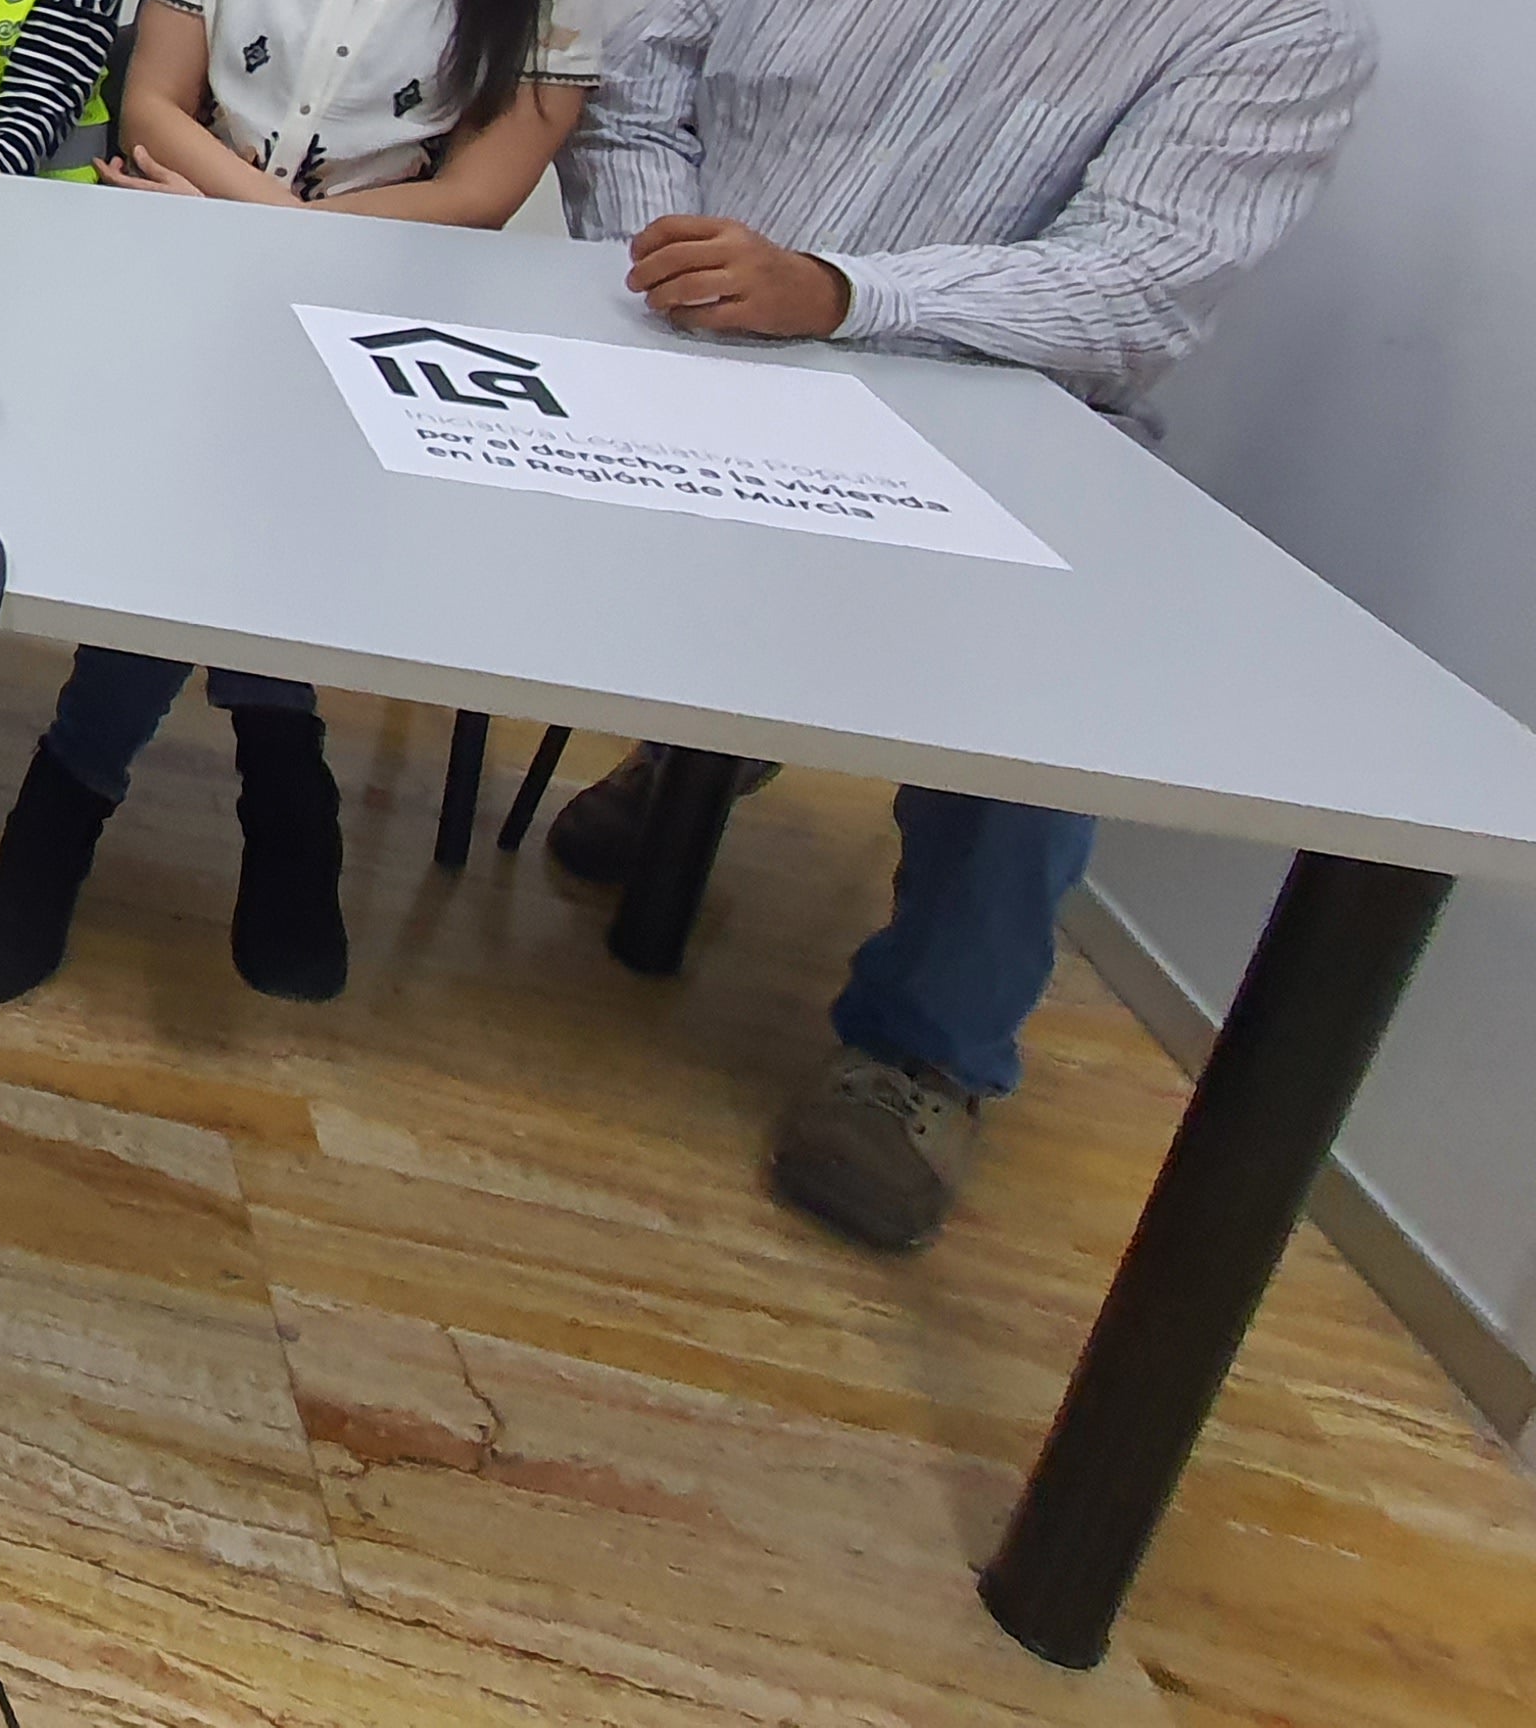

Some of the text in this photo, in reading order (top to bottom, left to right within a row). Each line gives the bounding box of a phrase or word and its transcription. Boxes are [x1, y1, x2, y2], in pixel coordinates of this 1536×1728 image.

[417, 428, 475, 446] por
[487, 438, 520, 452] el
[531, 443, 688, 475] derecho
[728, 469, 766, 487] la
[775, 478, 951, 513] vivienda
[426, 446, 875, 520] en la Región de Murcia
